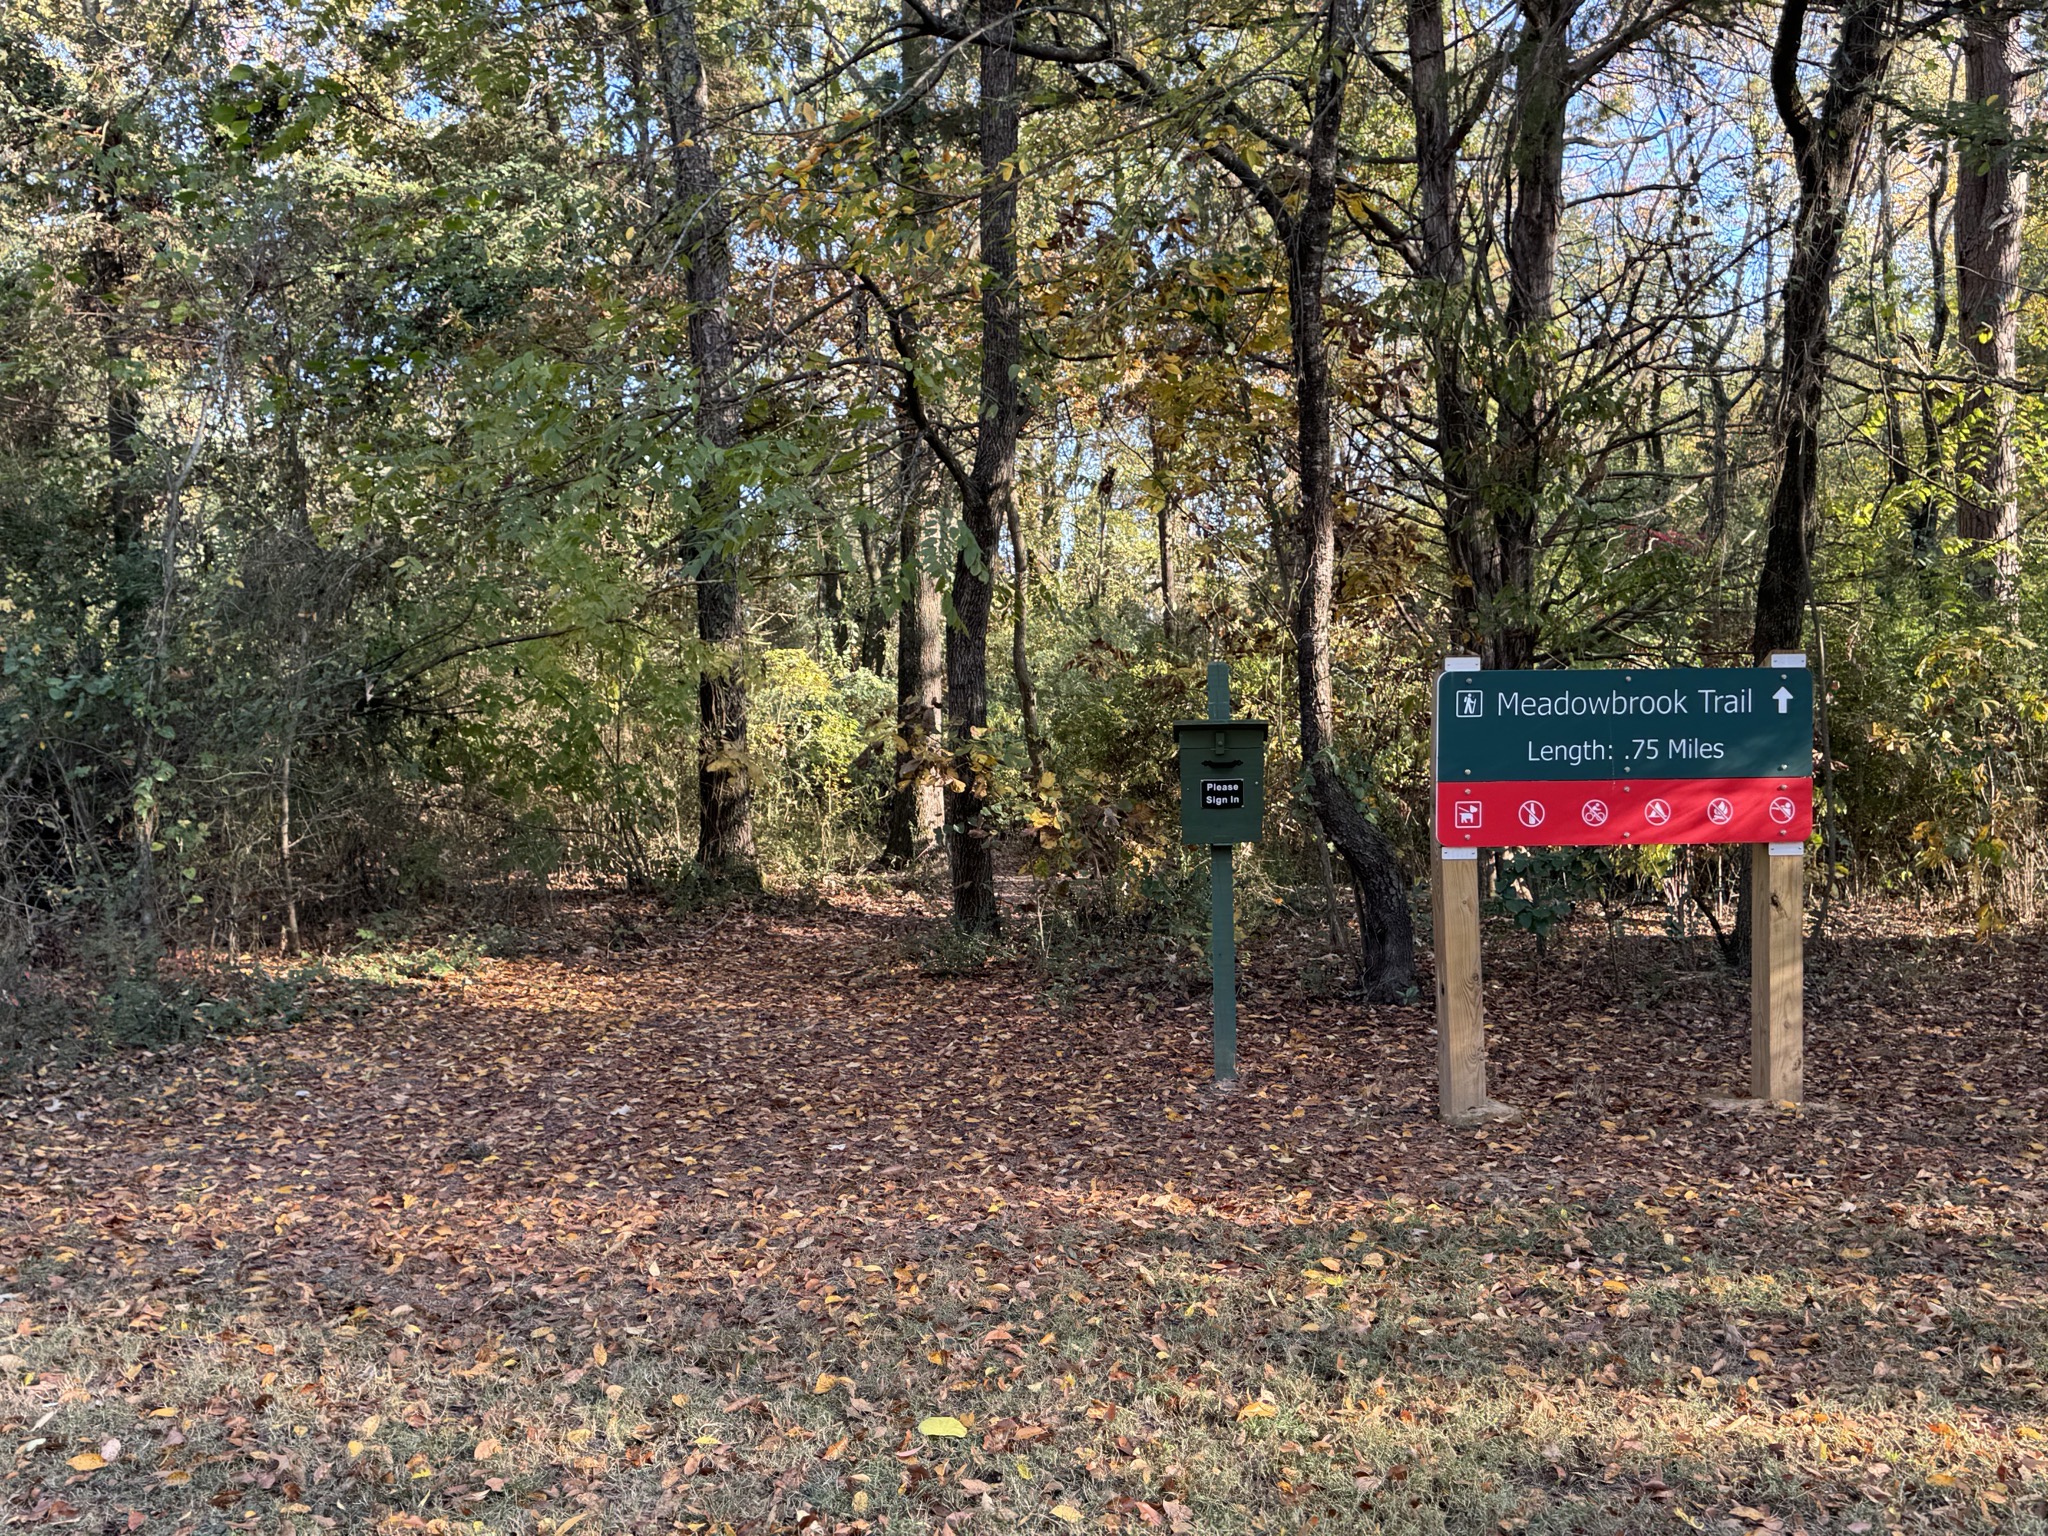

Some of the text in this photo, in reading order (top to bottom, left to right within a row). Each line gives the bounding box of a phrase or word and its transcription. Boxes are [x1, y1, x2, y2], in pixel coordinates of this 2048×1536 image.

[1497, 688, 1753, 716] Meadowbrook Trail
[1528, 738, 1724, 766] Length: .75 Miles
[1206, 783, 1239, 791] Please
[1206, 795, 1240, 805] Sign In
